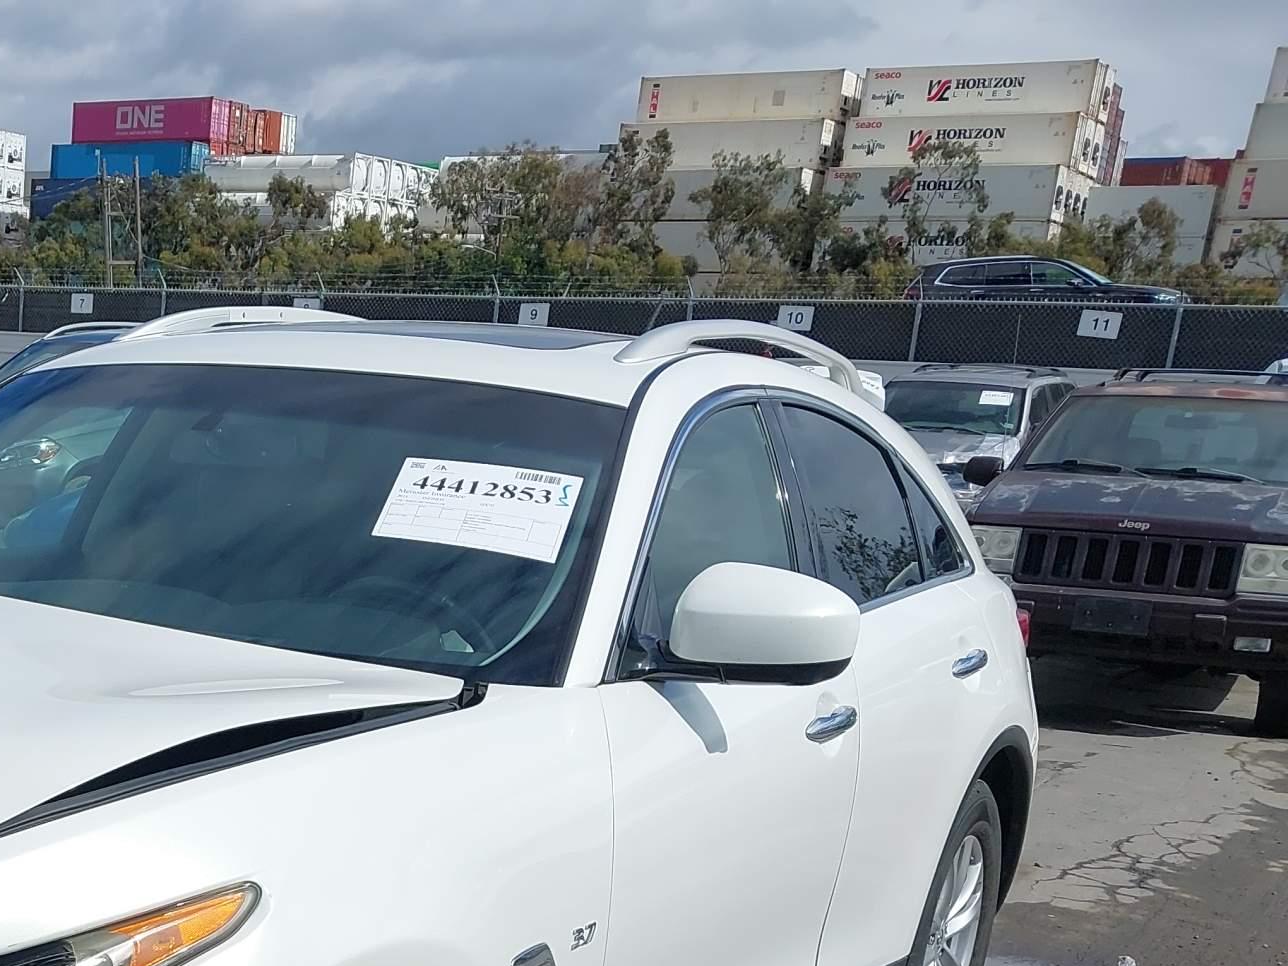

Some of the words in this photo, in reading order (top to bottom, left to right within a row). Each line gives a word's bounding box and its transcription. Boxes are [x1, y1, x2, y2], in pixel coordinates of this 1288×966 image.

[874, 71, 902, 80] seaco
[954, 76, 1026, 90] HORIZON
[952, 89, 1012, 98] LINES
[115, 105, 165, 129] ONE
[855, 121, 883, 129] seaco
[935, 127, 1007, 140] HORIZON
[79, 298, 86, 308] 7
[530, 308, 538, 320] 9
[787, 311, 804, 324] 10
[1092, 318, 1110, 331] 11
[412, 475, 552, 504] 44412853
[1118, 519, 1150, 531] Jeep
